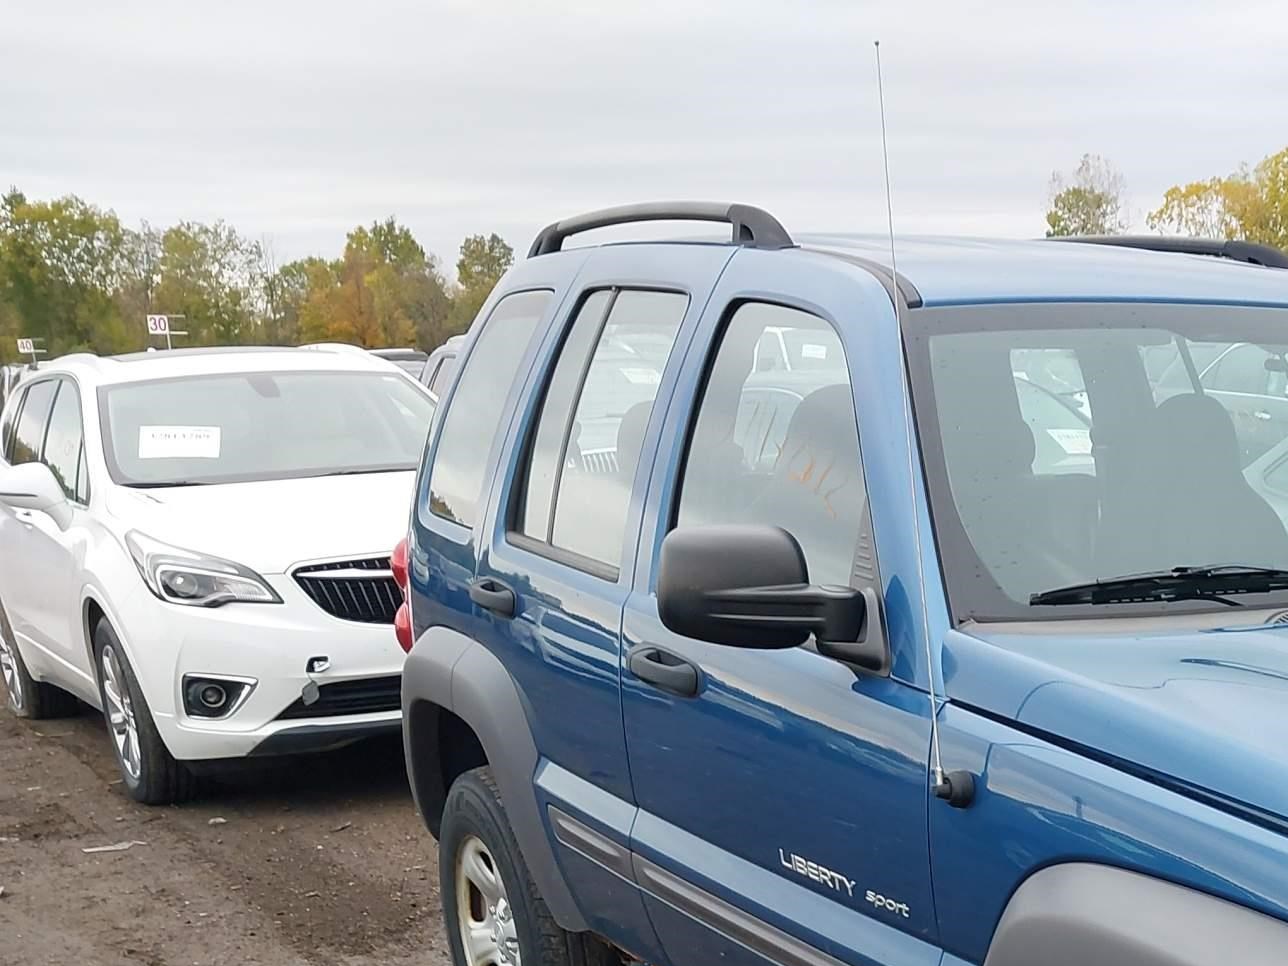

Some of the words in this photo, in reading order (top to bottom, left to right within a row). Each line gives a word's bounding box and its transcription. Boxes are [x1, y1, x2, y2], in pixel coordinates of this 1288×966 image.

[149, 316, 167, 332] 30
[779, 848, 856, 897] LIBERTY
[865, 890, 910, 918] sport
